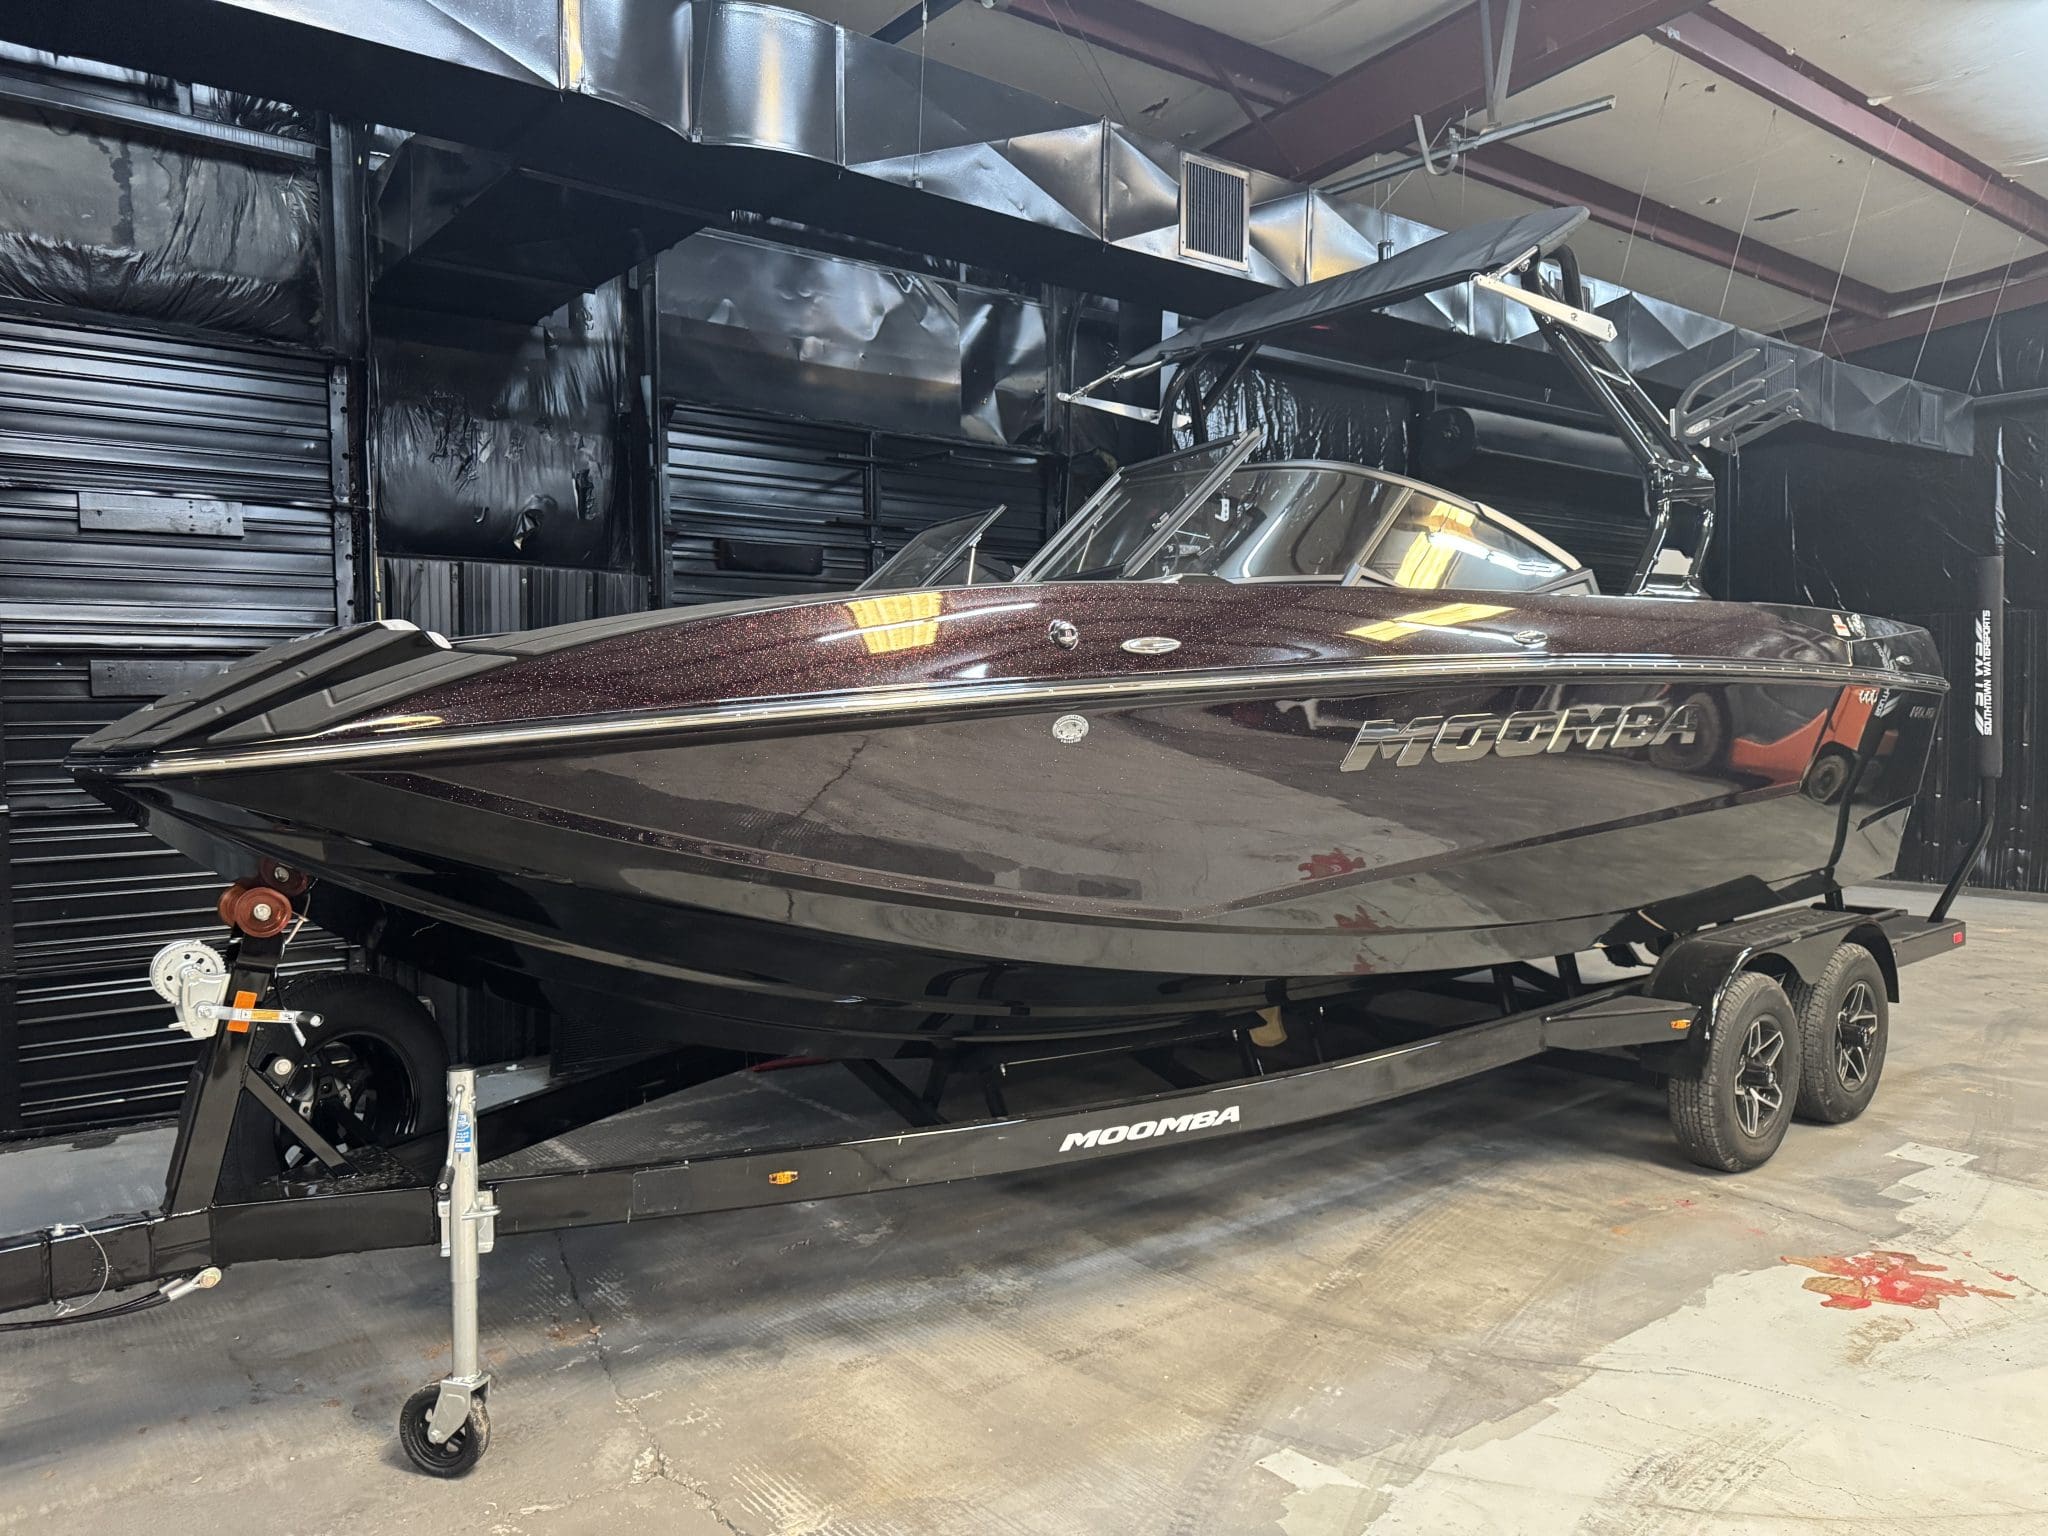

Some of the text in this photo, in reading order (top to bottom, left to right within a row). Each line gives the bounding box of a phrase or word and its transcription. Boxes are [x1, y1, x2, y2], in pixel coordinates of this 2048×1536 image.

[1982, 610, 1993, 736] SOUTHTOWN WATERSPORTS
[1339, 703, 1702, 772] MOOMBA
[1059, 1105, 1240, 1152] MOOMBA
